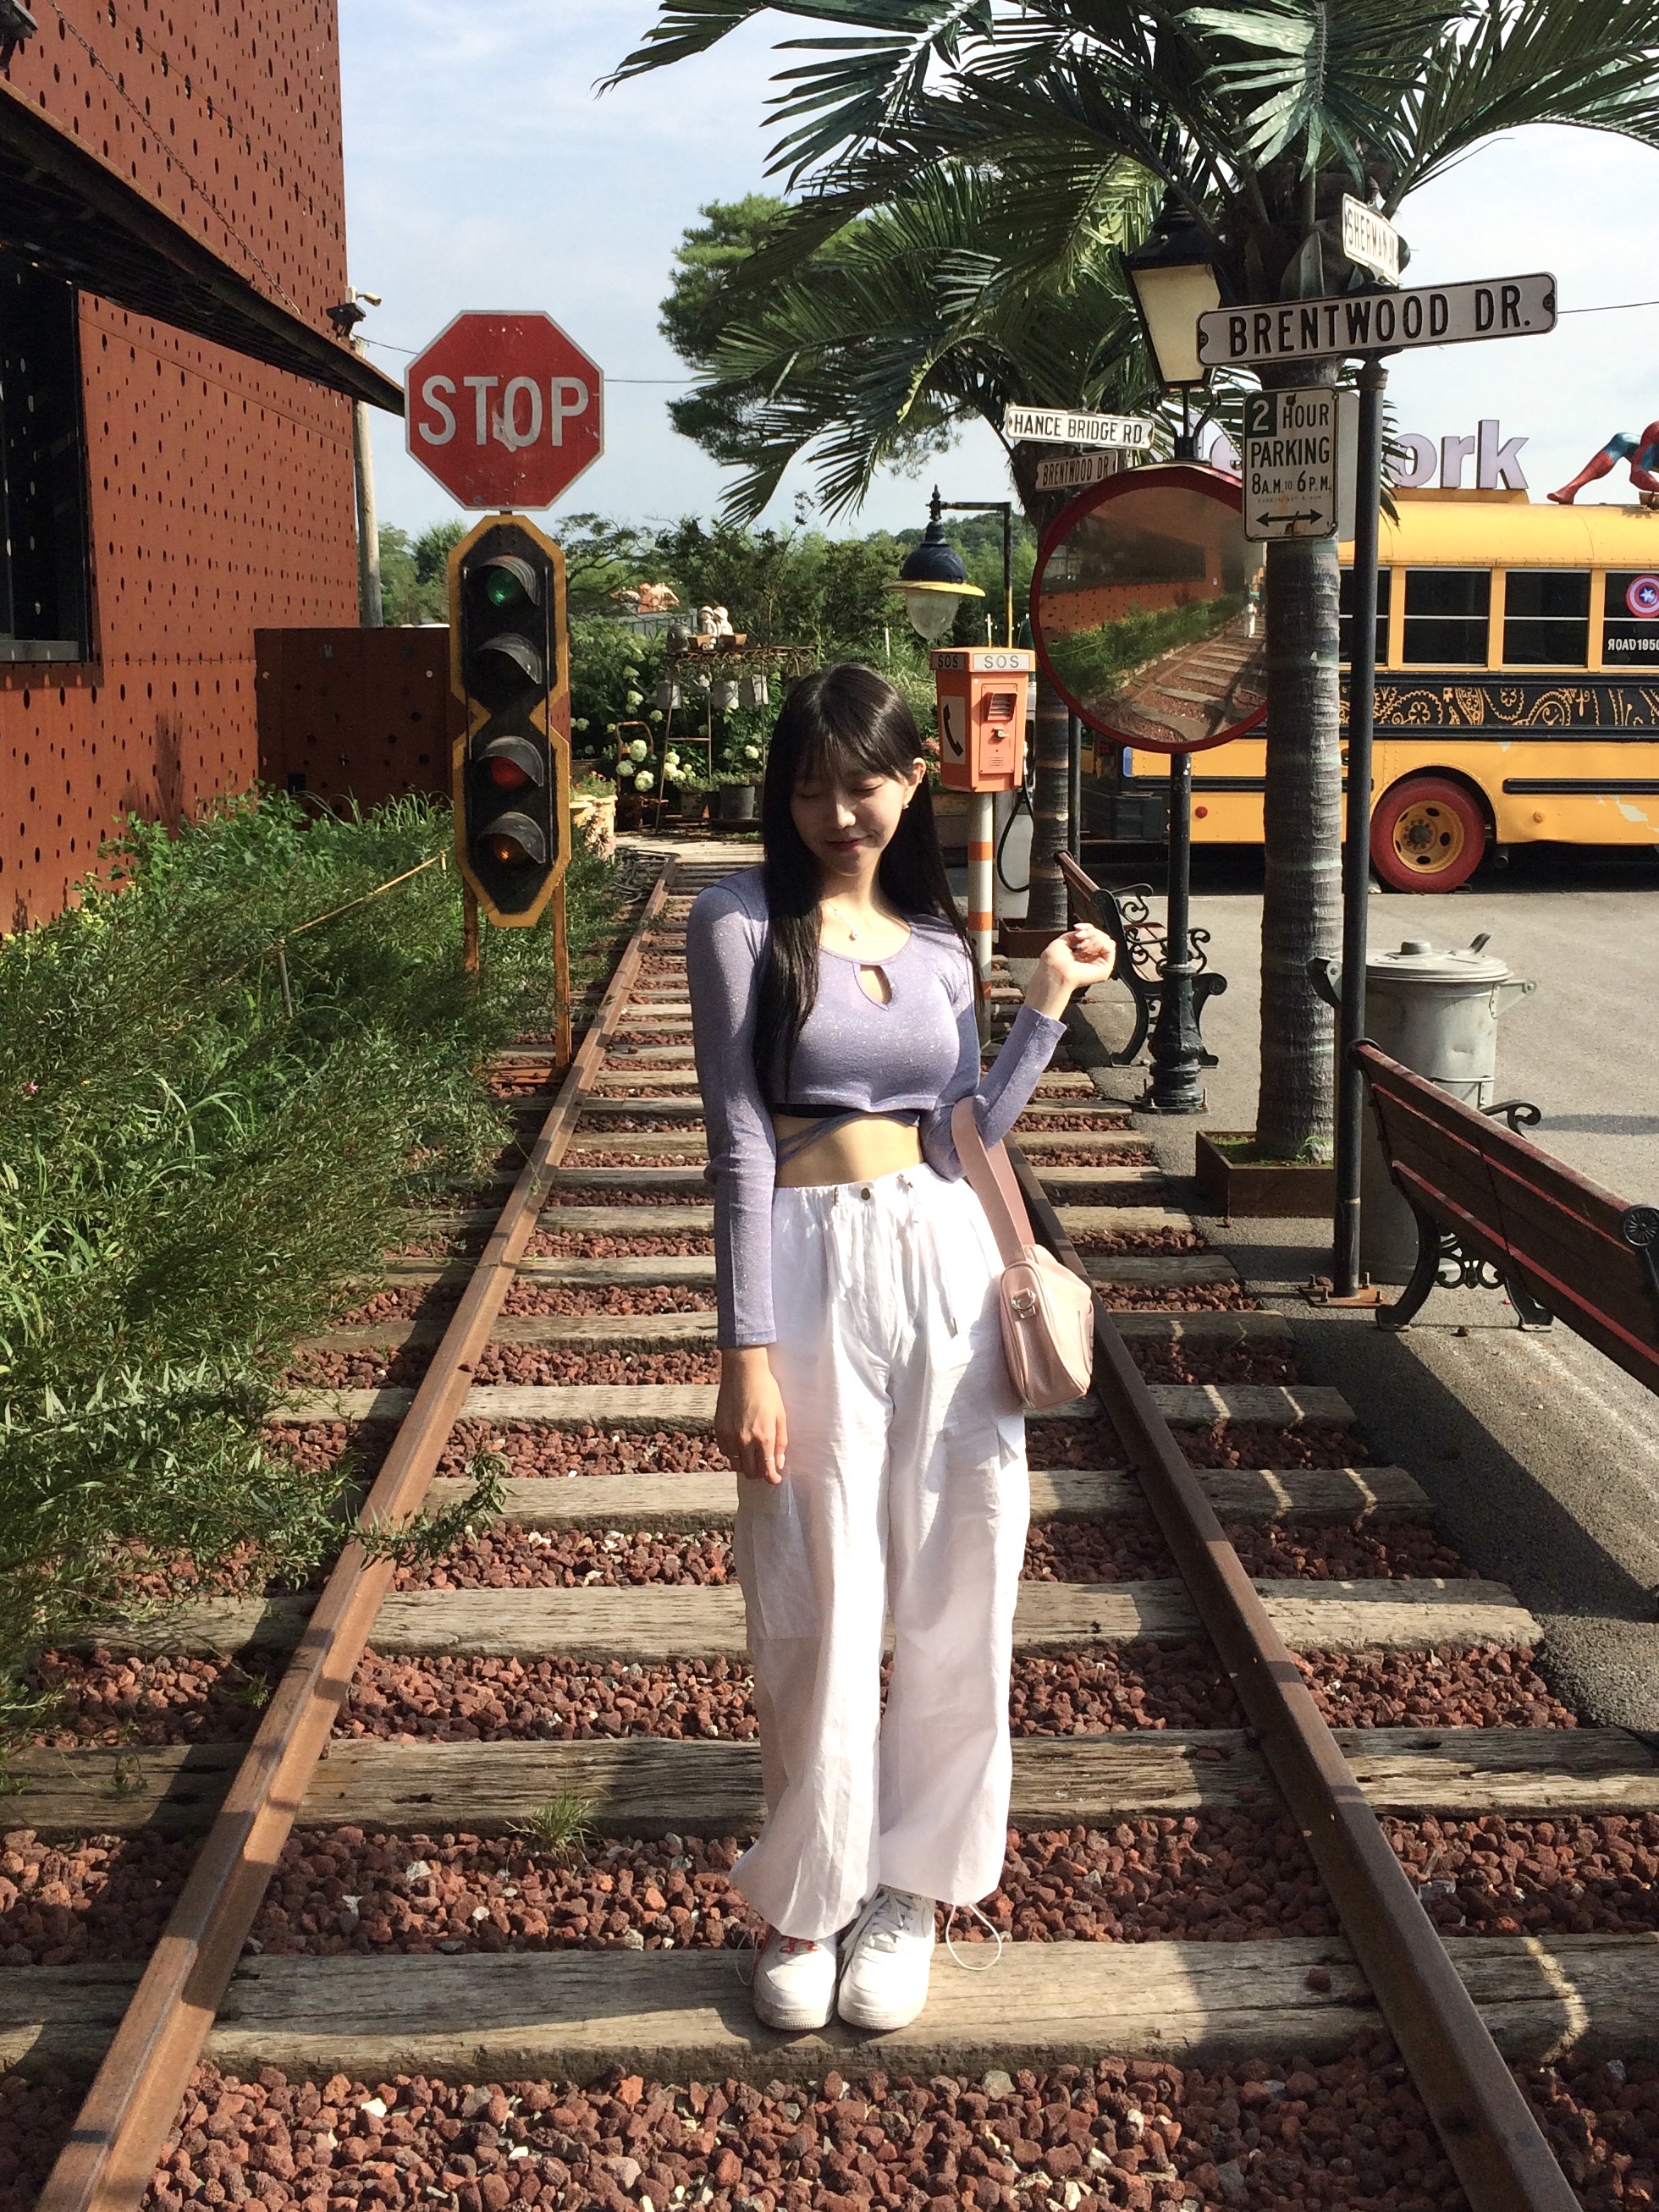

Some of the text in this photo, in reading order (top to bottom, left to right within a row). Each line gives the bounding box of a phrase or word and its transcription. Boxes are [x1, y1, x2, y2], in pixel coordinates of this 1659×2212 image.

[1348, 208, 1387, 263] SHERMAN
[1229, 284, 1531, 358] BRENTWOOD DR.
[418, 375, 589, 447] STOP
[1252, 399, 1330, 432] 2 HOUR
[1014, 413, 1145, 445] HANCE BRIDGE RD.
[1250, 436, 1330, 469] PARKING
[1385, 420, 1529, 489] ork
[1042, 458, 1093, 487] BRENTWOOD
[1284, 481, 1292, 491] TO
[937, 654, 959, 669] SOS
[984, 655, 1019, 669] SOS
